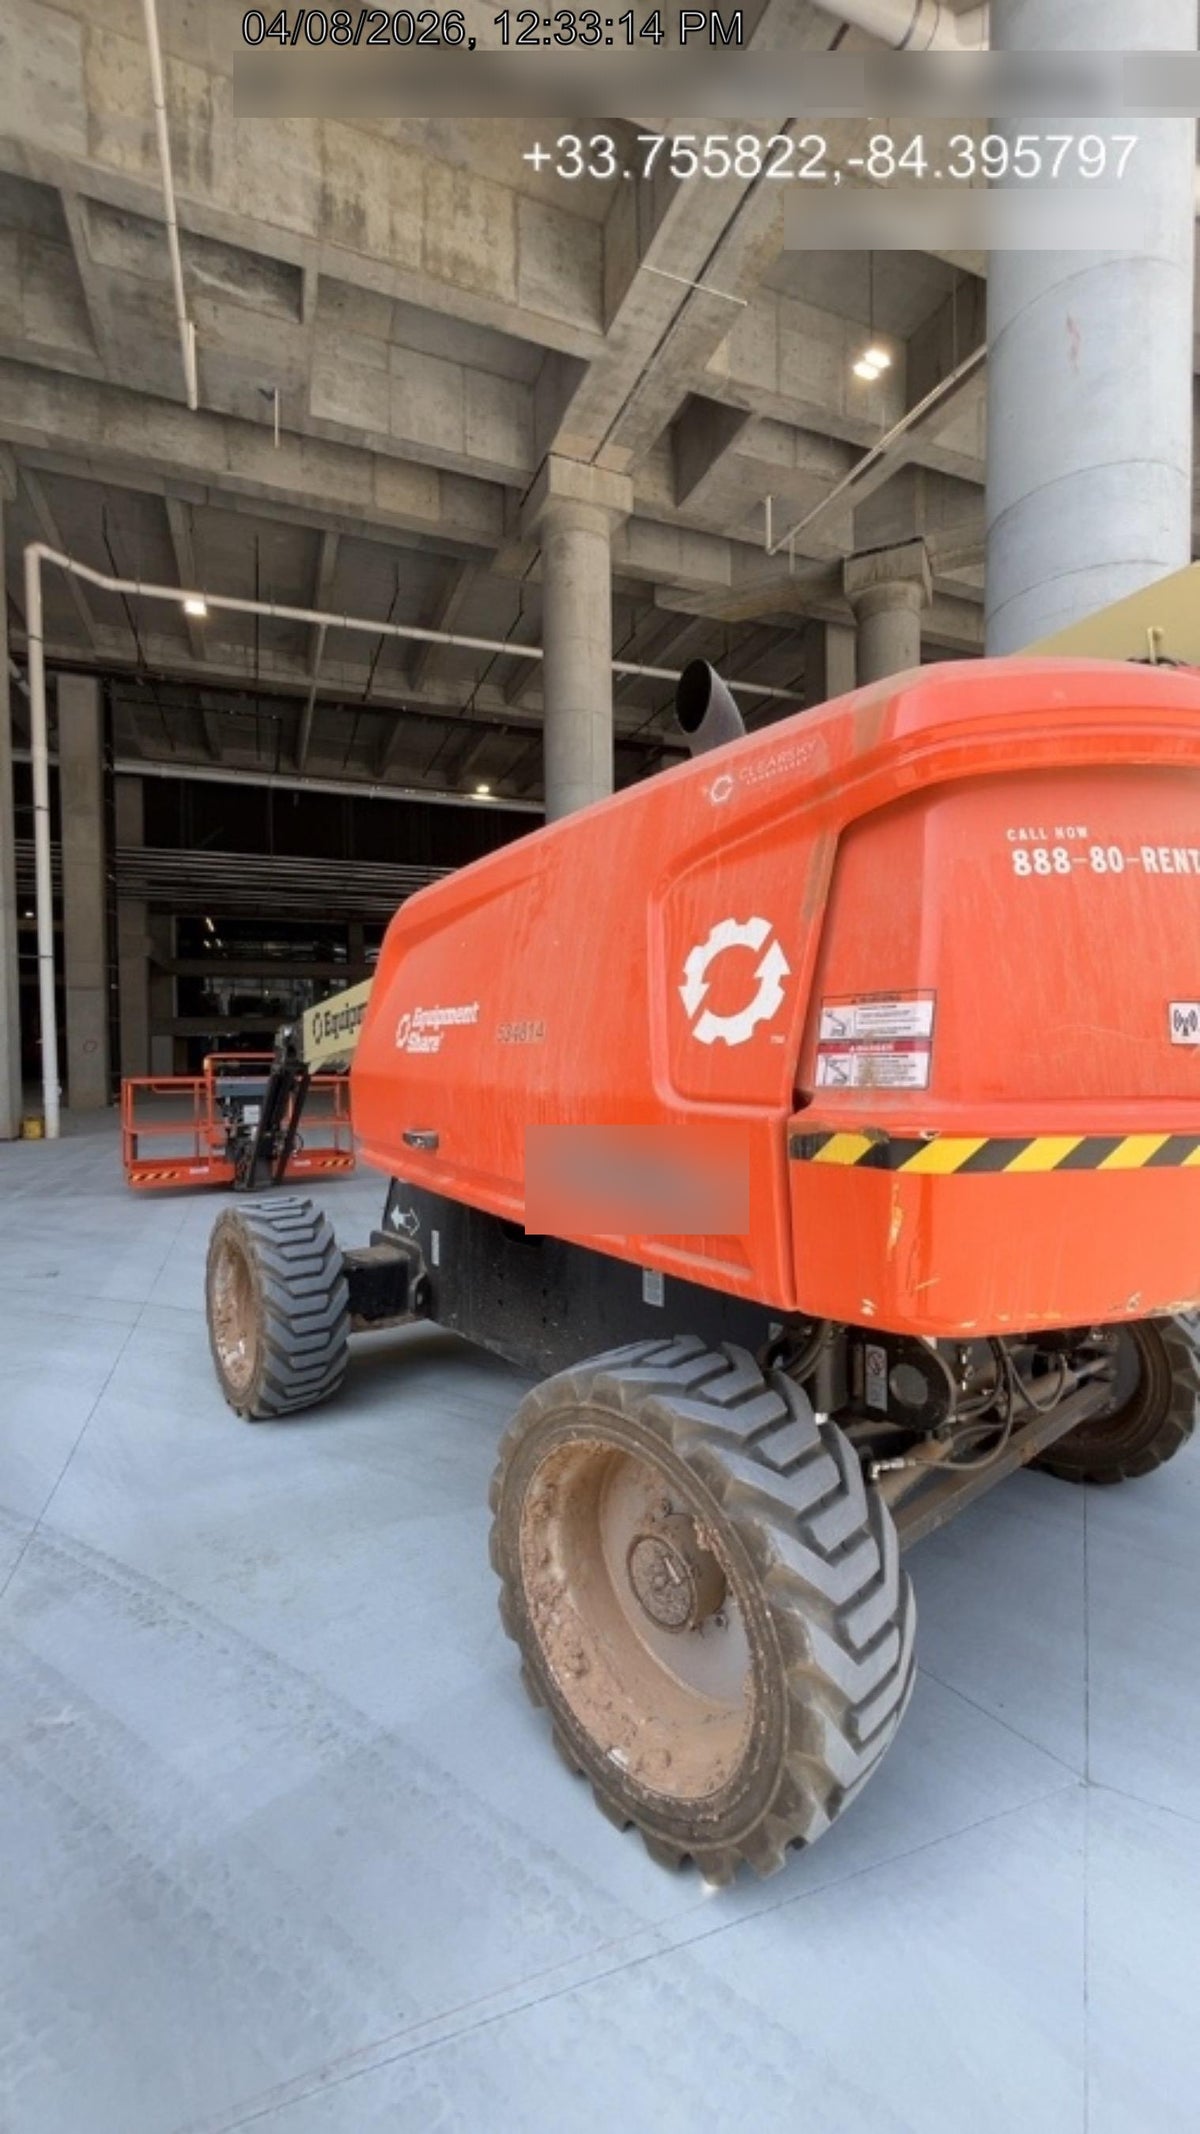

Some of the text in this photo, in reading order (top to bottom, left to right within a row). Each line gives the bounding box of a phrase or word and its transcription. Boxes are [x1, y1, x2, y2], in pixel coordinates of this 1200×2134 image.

[1007, 827, 1088, 841] CALL NOW
[412, 1001, 479, 1031] Equipment
[407, 1032, 443, 1052] Share
